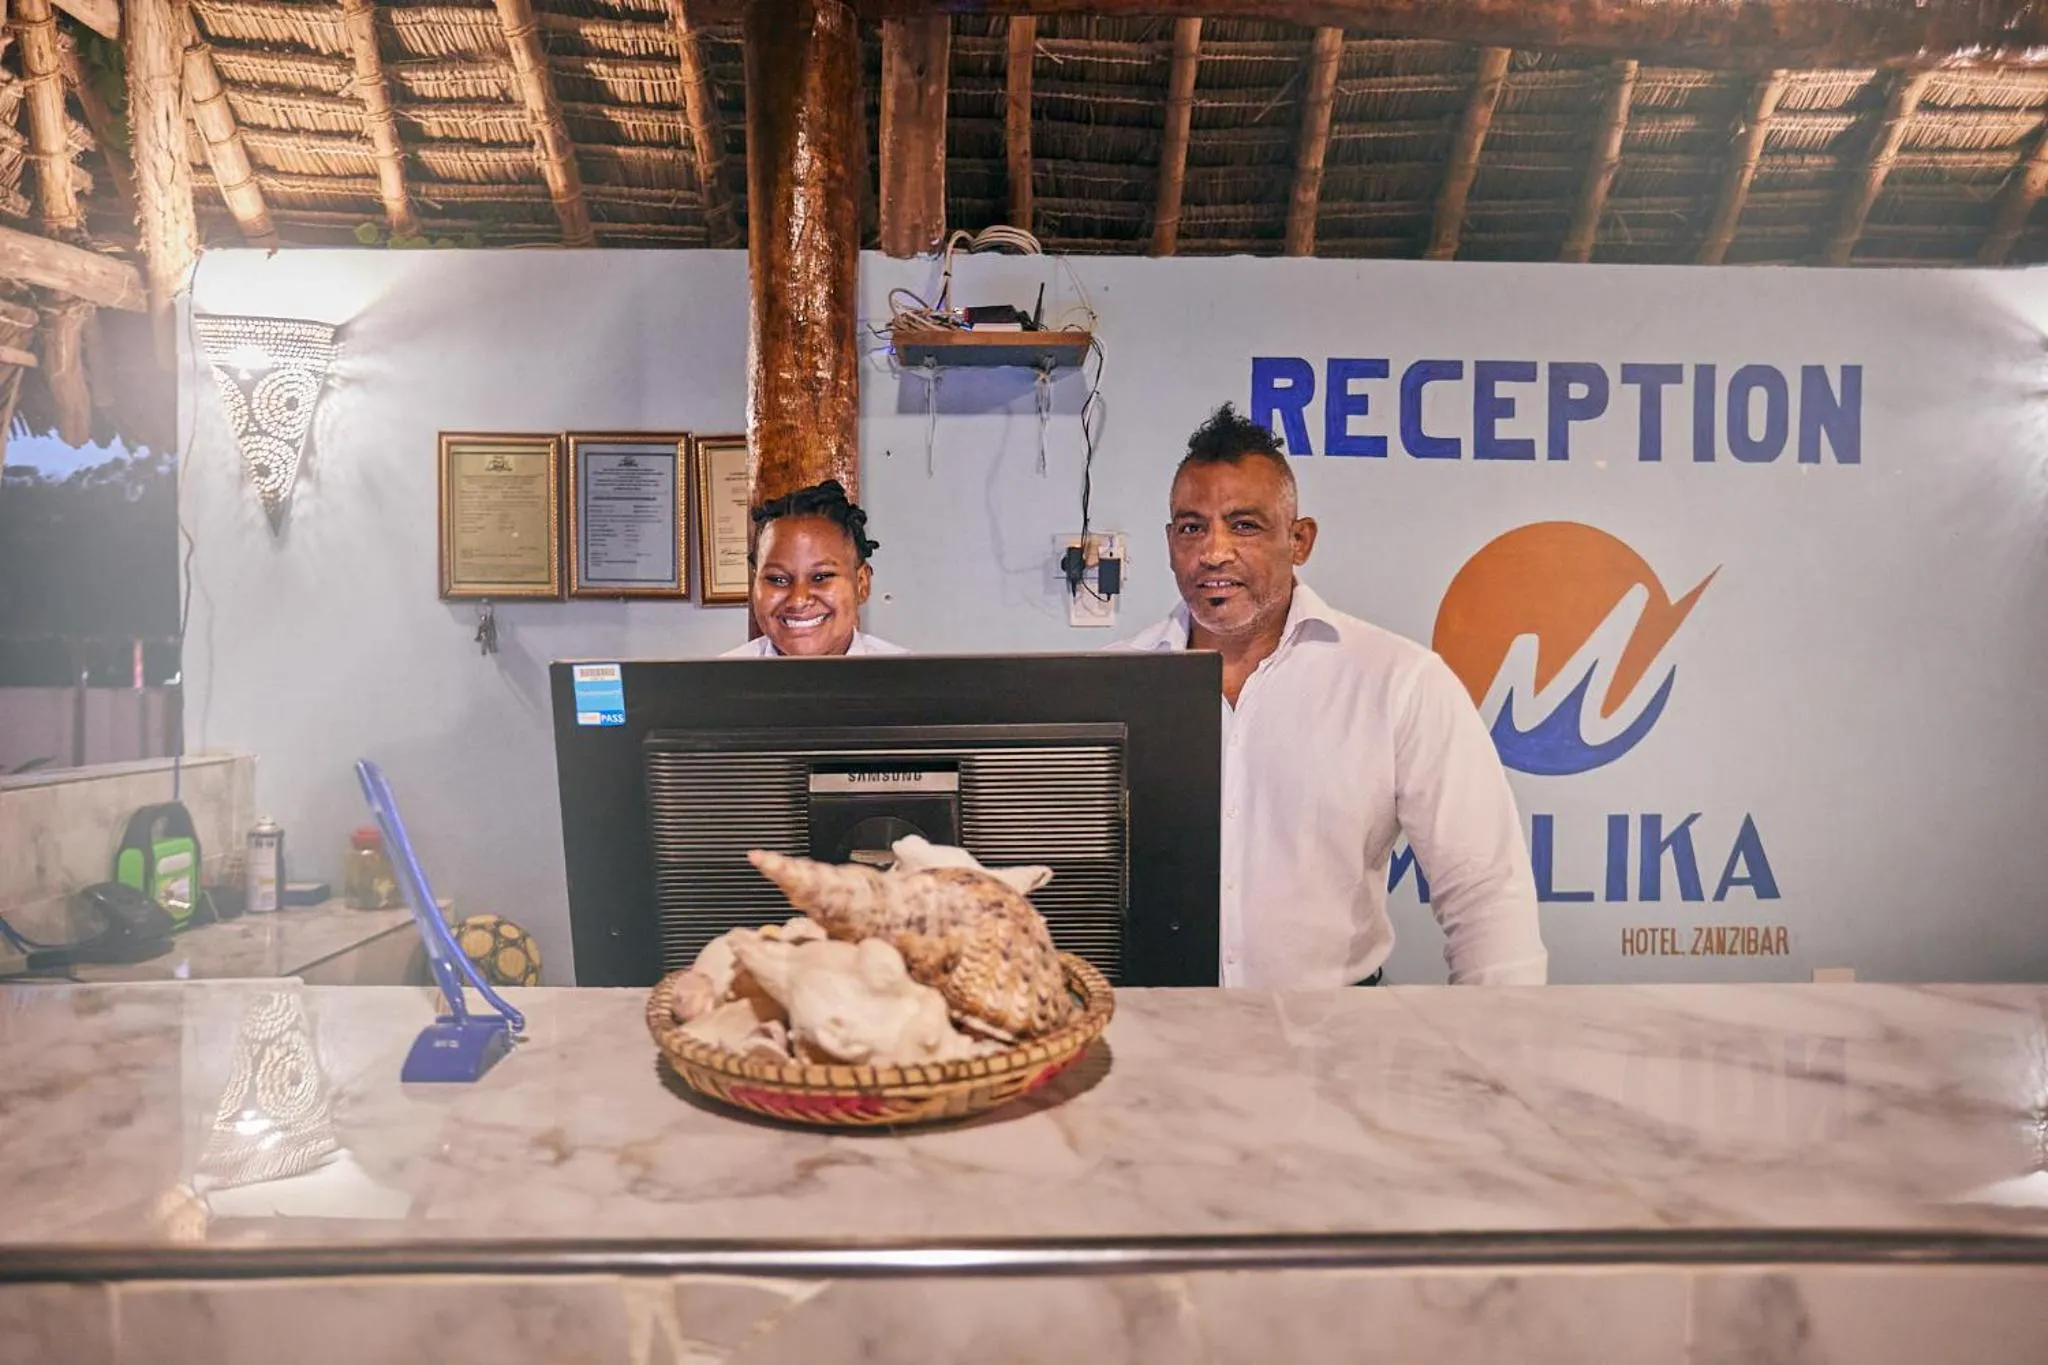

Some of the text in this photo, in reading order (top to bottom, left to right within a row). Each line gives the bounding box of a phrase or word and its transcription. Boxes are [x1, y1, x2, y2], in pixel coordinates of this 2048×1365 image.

[1251, 356, 1863, 465] RECEPTION
[601, 713, 625, 723] PASS
[1690, 926, 1790, 956] ZANZIBAR
